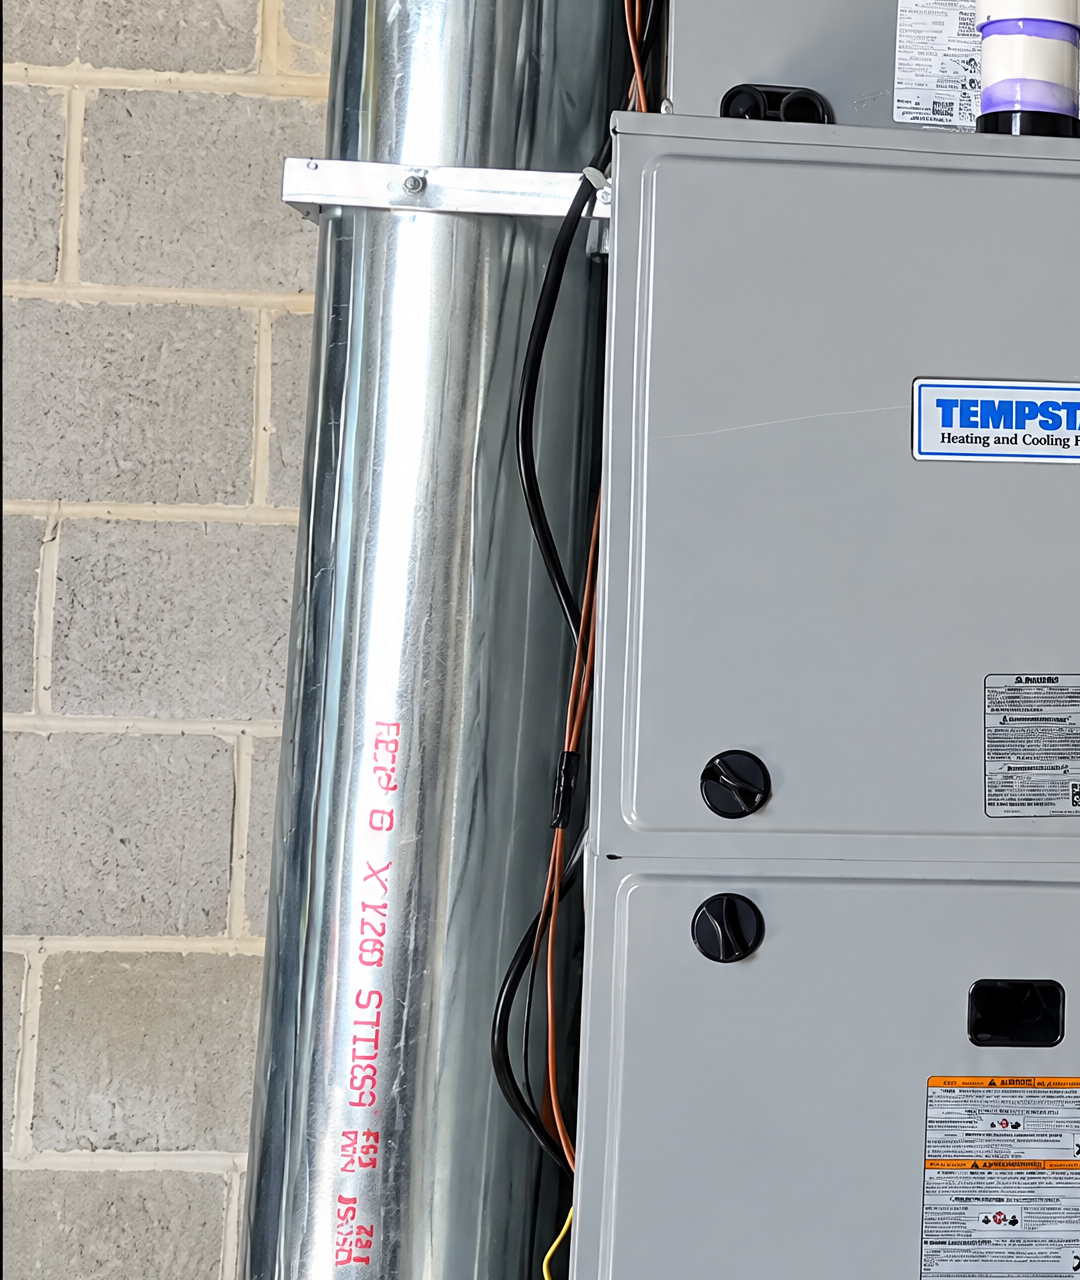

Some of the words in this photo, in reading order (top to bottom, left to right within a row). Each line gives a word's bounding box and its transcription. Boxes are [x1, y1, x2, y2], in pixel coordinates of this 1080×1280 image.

[940, 432, 990, 448] Heating
[994, 434, 1018, 446] and
[1022, 434, 1070, 449] Cooling
